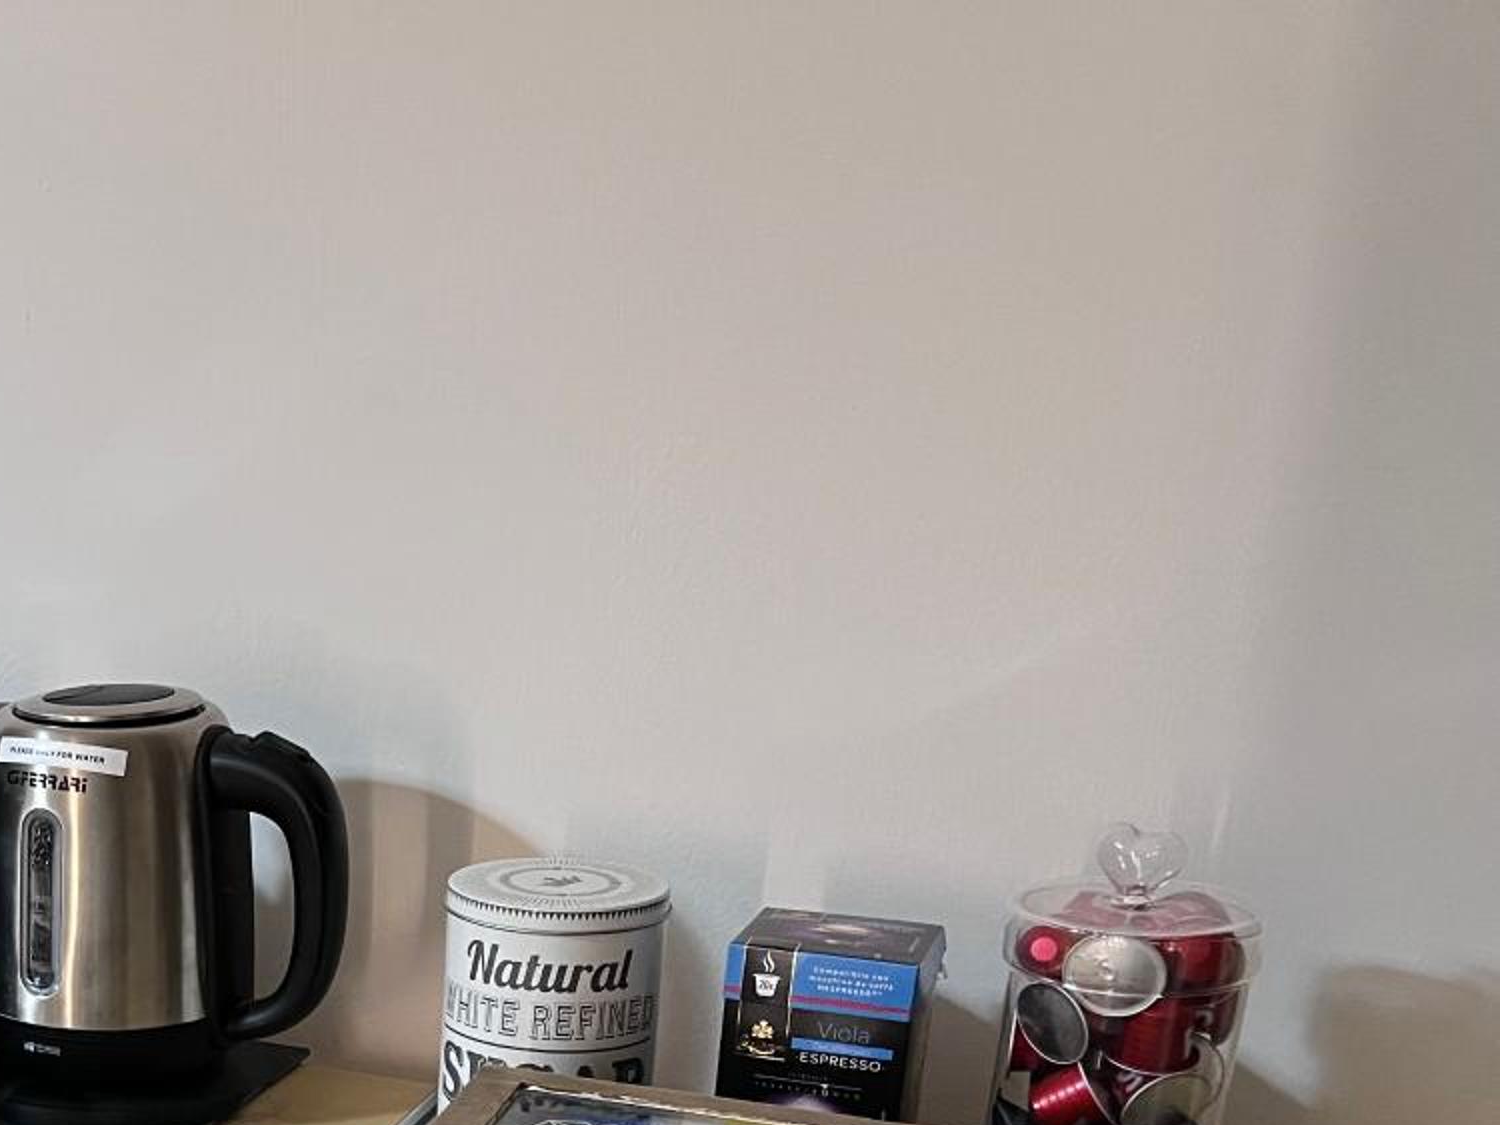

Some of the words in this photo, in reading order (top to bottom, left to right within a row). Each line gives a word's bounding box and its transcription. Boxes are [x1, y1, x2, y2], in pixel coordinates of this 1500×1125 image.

[75, 753, 105, 764] WATER
[467, 939, 634, 994] Natural
[816, 1021, 871, 1045] Viola
[799, 1050, 882, 1074] ESPRESSO
